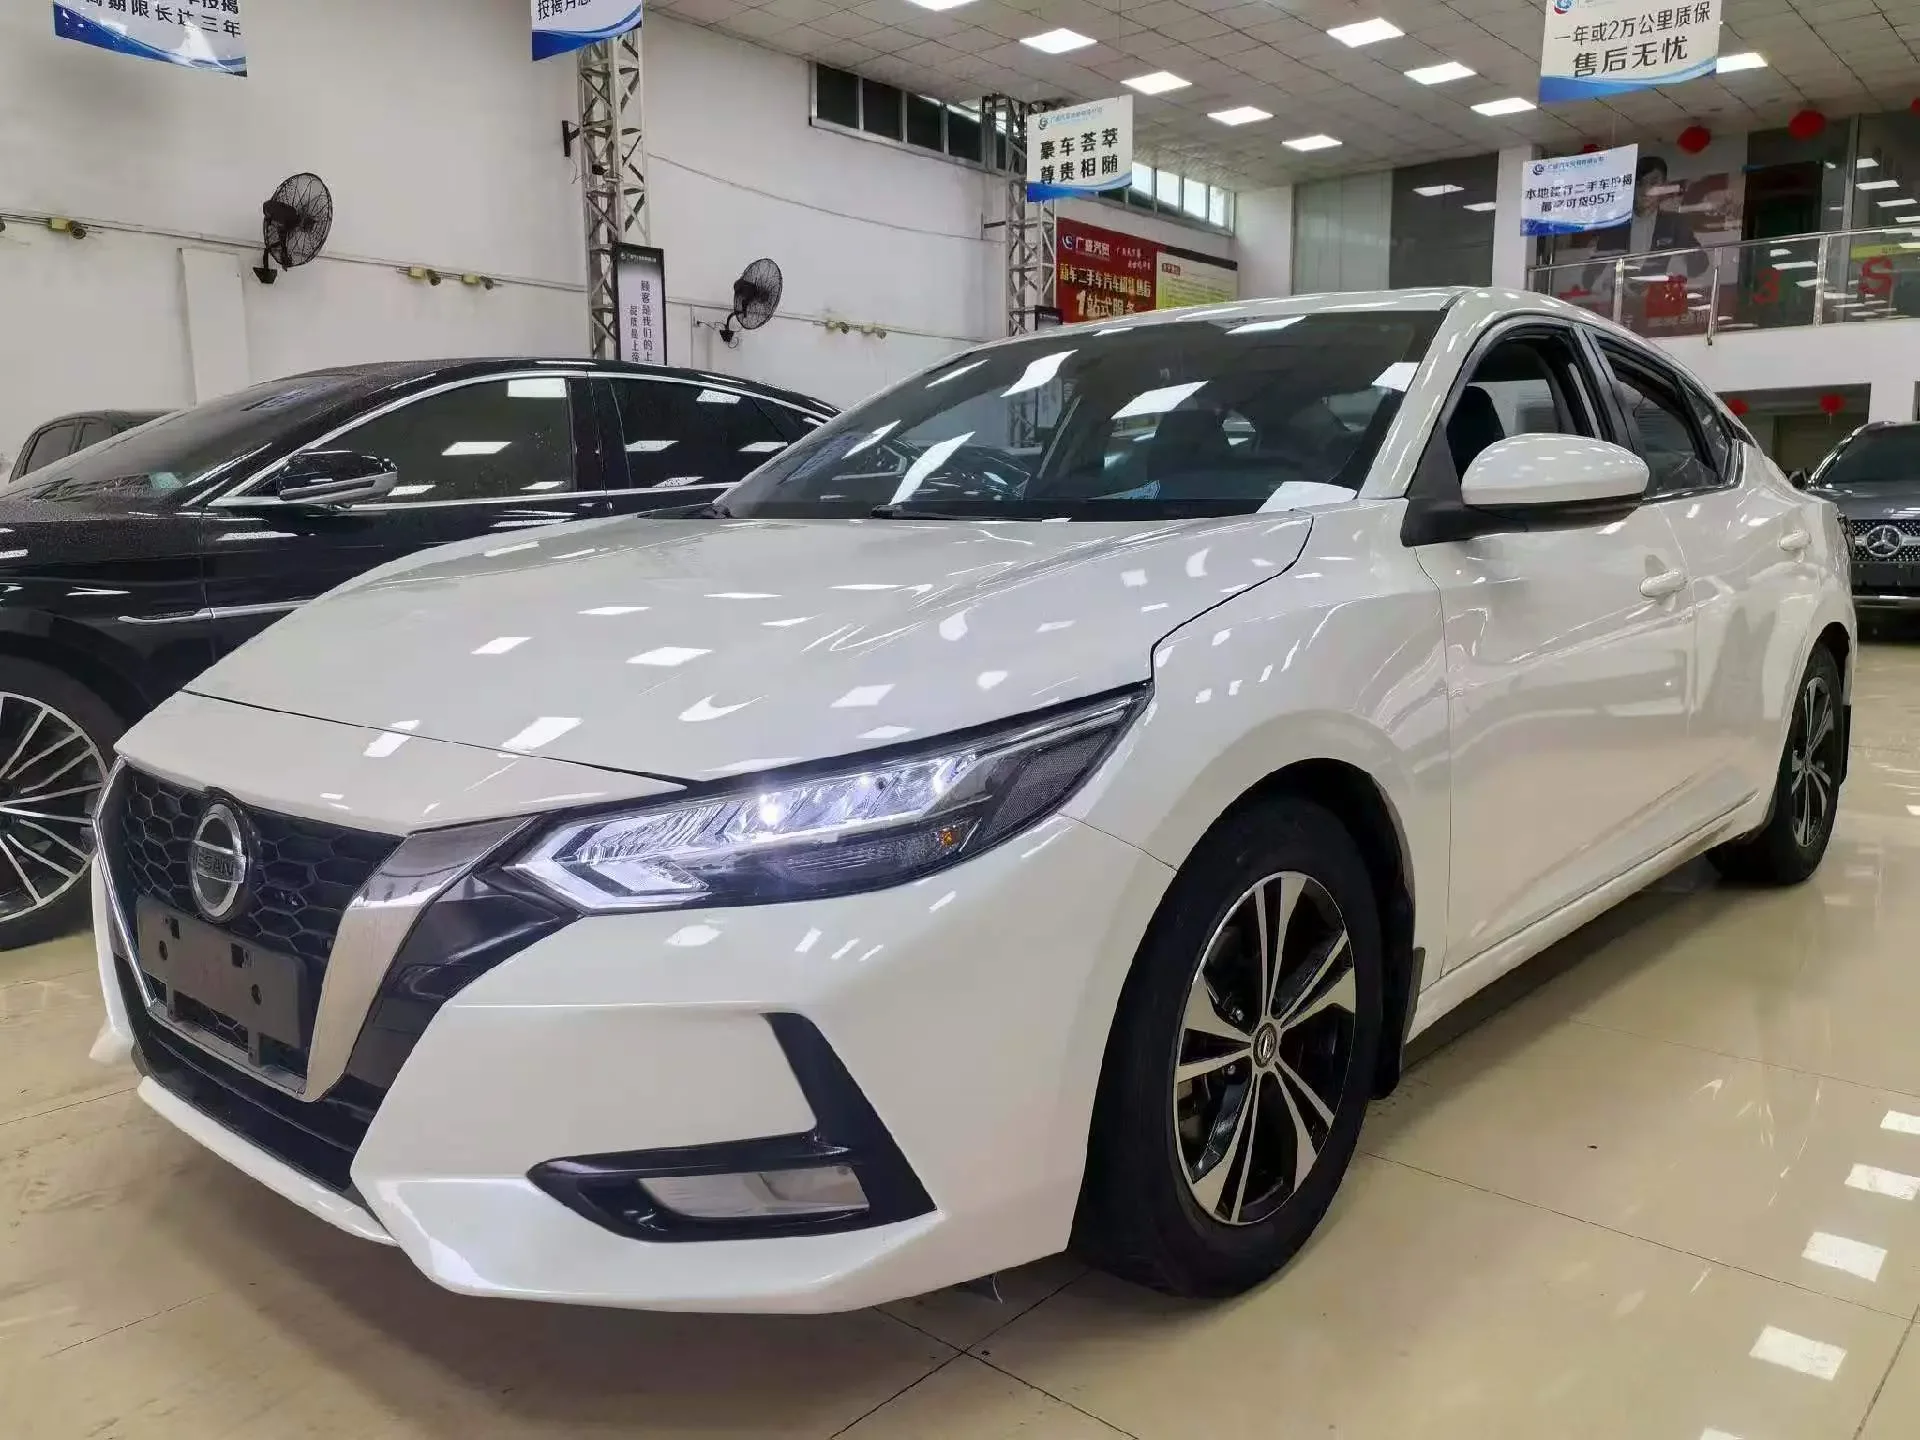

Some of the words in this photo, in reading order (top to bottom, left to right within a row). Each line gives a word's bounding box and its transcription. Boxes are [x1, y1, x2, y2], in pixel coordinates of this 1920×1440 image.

[1554, 1, 1711, 45] 一年或2万公里质保
[1573, 35, 1688, 77] 售后无忧
[1040, 127, 1118, 160] 豪车荟萃
[1040, 154, 1118, 184] 尊贵相随
[197, 846, 235, 879] SSAN
